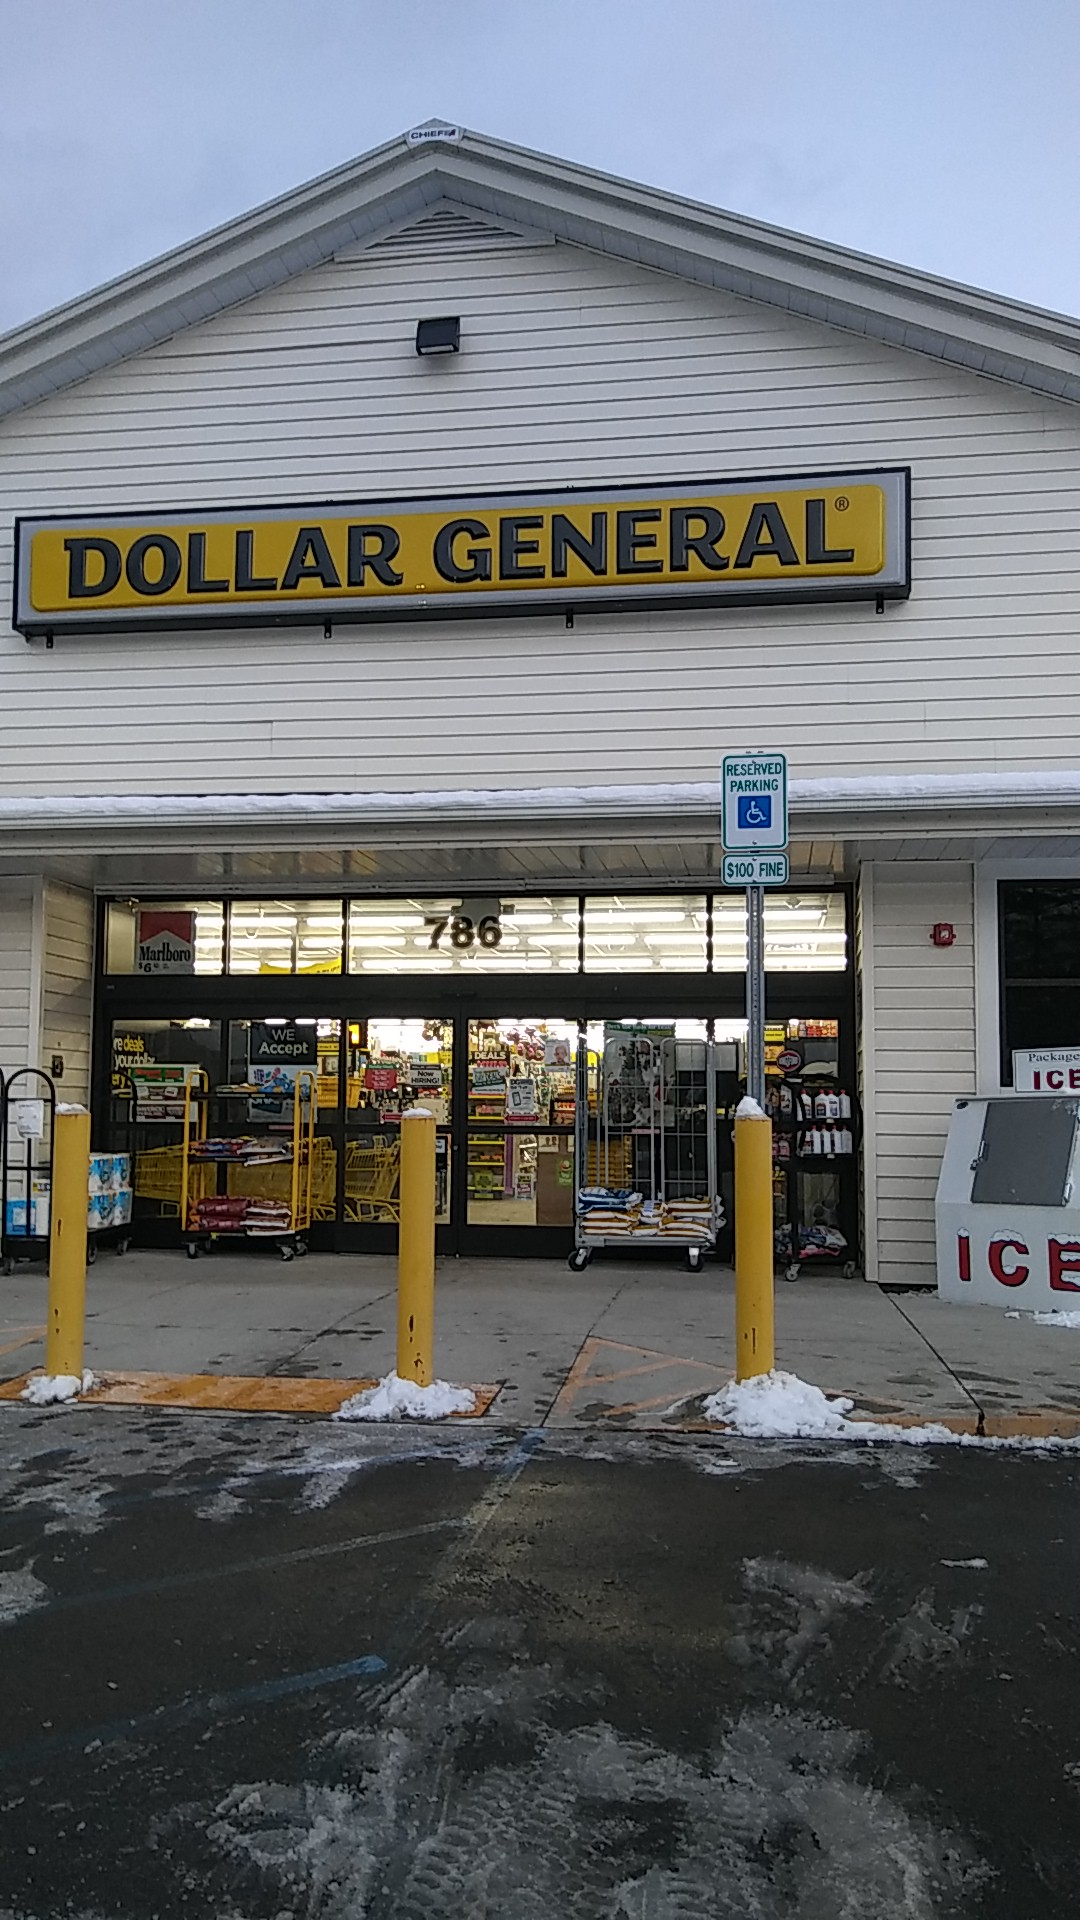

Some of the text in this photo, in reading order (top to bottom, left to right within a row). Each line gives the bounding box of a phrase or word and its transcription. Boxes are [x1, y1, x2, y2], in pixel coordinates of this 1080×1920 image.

[64, 498, 855, 599] DOLLAR GENERAL
[726, 762, 783, 777] RESERVED
[729, 779, 779, 793] PARKING
[726, 861, 784, 879] $100 FINE
[423, 915, 503, 950] 786
[139, 942, 192, 962] Marlboro
[123, 1033, 145, 1053] deals
[271, 1028, 296, 1041] WE
[259, 1041, 309, 1057] Accept
[474, 1051, 507, 1060] DEALS
[1033, 1069, 1080, 1091] ICE
[957, 1228, 1080, 1293] ICE
